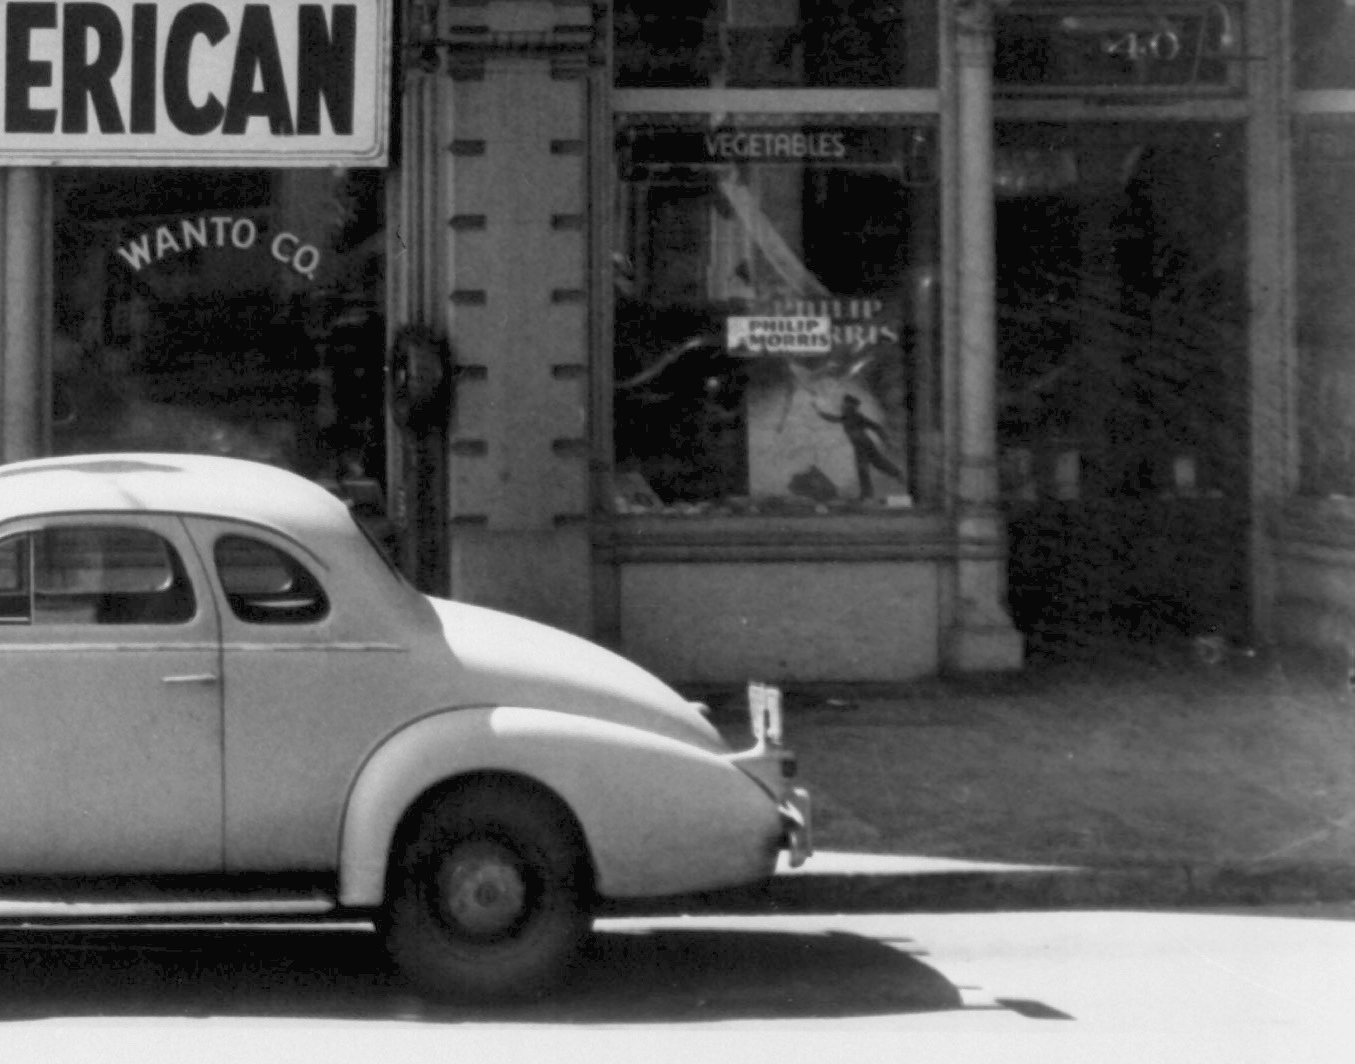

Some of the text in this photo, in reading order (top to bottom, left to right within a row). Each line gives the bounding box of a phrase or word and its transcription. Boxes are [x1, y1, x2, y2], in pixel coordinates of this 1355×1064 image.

[705, 132, 845, 158] VEGETABLES
[118, 216, 257, 272] WANTO
[749, 320, 820, 333] PHILIP
